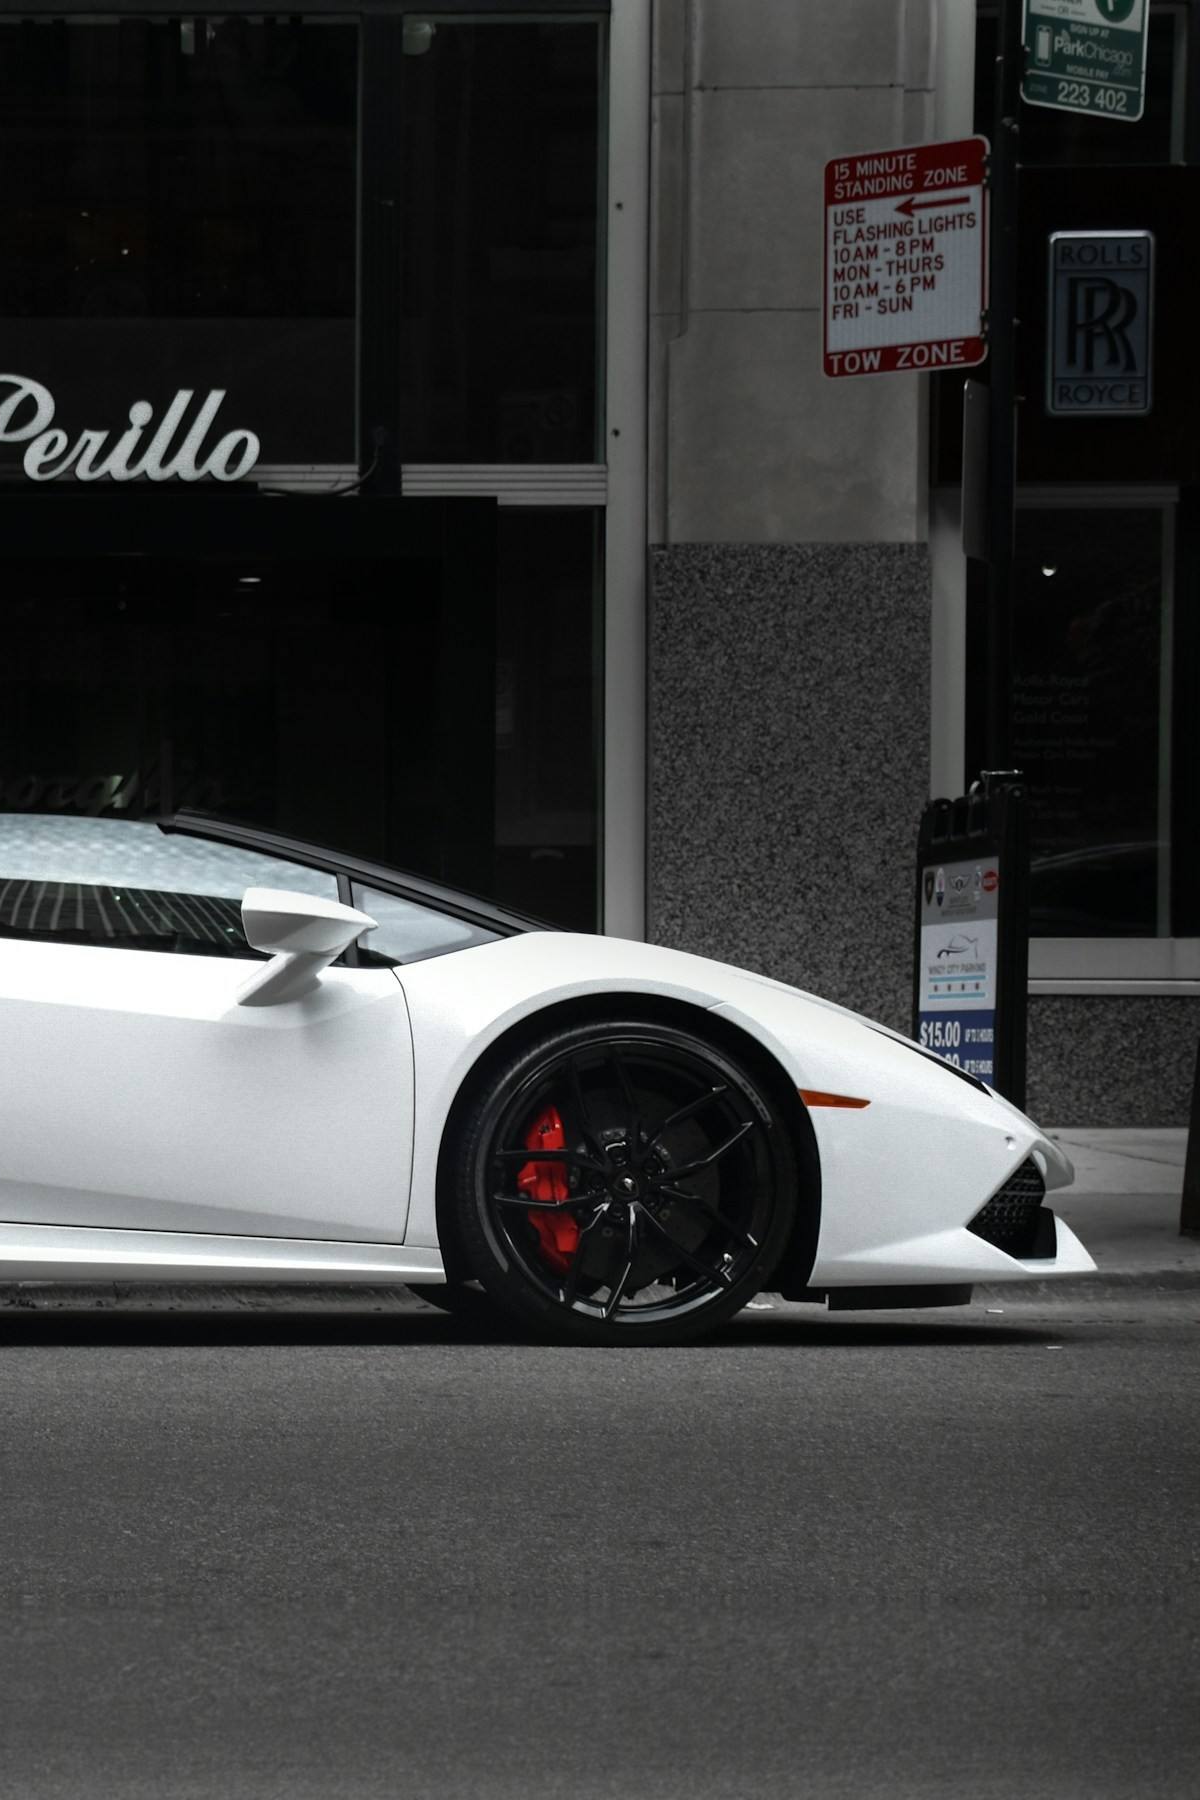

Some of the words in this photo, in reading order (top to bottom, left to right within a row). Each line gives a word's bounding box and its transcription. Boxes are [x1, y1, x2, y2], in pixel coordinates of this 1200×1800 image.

[1054, 35, 1133, 65] ParkChicago
[1057, 81, 1090, 106] 223
[1094, 88, 1127, 112] 402
[834, 162, 849, 180] 15
[856, 153, 917, 177] MINUTE
[834, 173, 913, 199] STANDING
[923, 165, 967, 187] ZONE
[833, 208, 865, 227] USE
[833, 220, 913, 246] FLASHING
[918, 212, 976, 235] LIGHTS
[1060, 243, 1143, 265] ROLLS
[833, 264, 870, 283] MON
[886, 255, 944, 277] THURS
[832, 302, 859, 320] FRI
[877, 296, 913, 315] SUN
[828, 350, 882, 375] TOW
[896, 341, 965, 368] ZONE
[1058, 383, 1142, 405] ROYCE
[919, 1021, 960, 1047] $15.00
